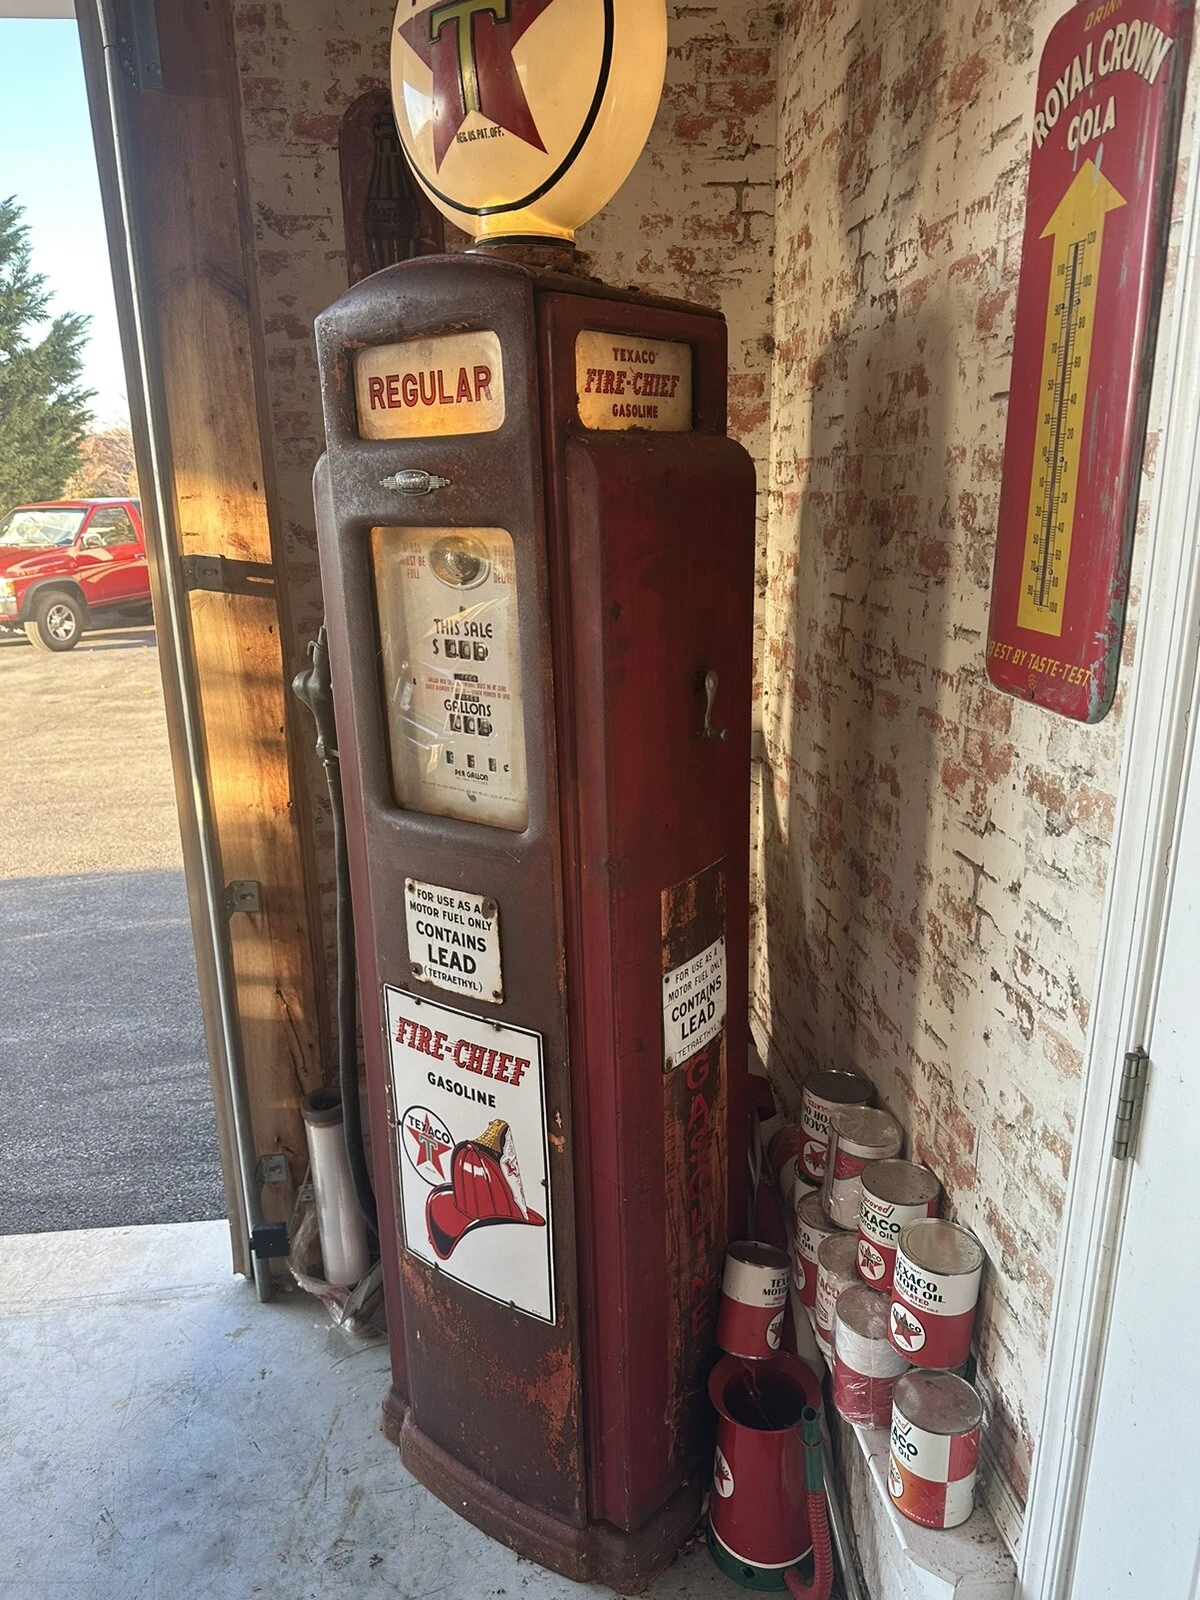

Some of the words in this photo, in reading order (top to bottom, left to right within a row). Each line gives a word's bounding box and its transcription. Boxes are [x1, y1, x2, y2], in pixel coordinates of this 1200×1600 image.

[1033, 41, 1093, 149] ROYAL
[1098, 18, 1174, 85] CROWN
[1067, 95, 1116, 151] COLA
[612, 347, 656, 364] TEXACO
[368, 364, 493, 411] REGULAR
[584, 367, 680, 398] FIRE-CHIEF
[612, 403, 658, 419] GASOLINE
[433, 618, 460, 636] THIS
[463, 621, 493, 639] SALE
[1011, 648, 1027, 666] BY
[1028, 653, 1092, 687] TASTE-TEST
[443, 698, 492, 717] GALLONS
[454, 769, 468, 778] PER
[467, 770, 489, 782] GALLON
[410, 900, 439, 918] MOTOR
[442, 910, 465, 925] FUEL
[468, 917, 492, 931] ONLY
[417, 888, 434, 903] FOR
[437, 894, 454, 908] USE
[458, 900, 471, 912] AS
[474, 903, 482, 914] A
[415, 920, 487, 953] CONTAINS
[427, 943, 477, 974] LEAD
[675, 968, 689, 983] FOR
[691, 958, 703, 973] USE
[705, 953, 713, 965] AS
[424, 965, 483, 993] (TETRAETHYL)
[668, 982, 692, 1002] MOTOR
[694, 971, 709, 986] FUEL
[710, 958, 723, 973] ONLY
[671, 974, 722, 1023] CONTAINS
[681, 1000, 715, 1040] LEAD
[394, 1016, 531, 1087] FIRE-CHIEF
[427, 1071, 496, 1108] GASOLINE
[407, 1114, 450, 1144] TEXACO
[860, 1201, 901, 1233] EXACO
[878, 1230, 894, 1241] OIL
[922, 1291, 946, 1304] OIL
[892, 1425, 919, 1456] ACO
